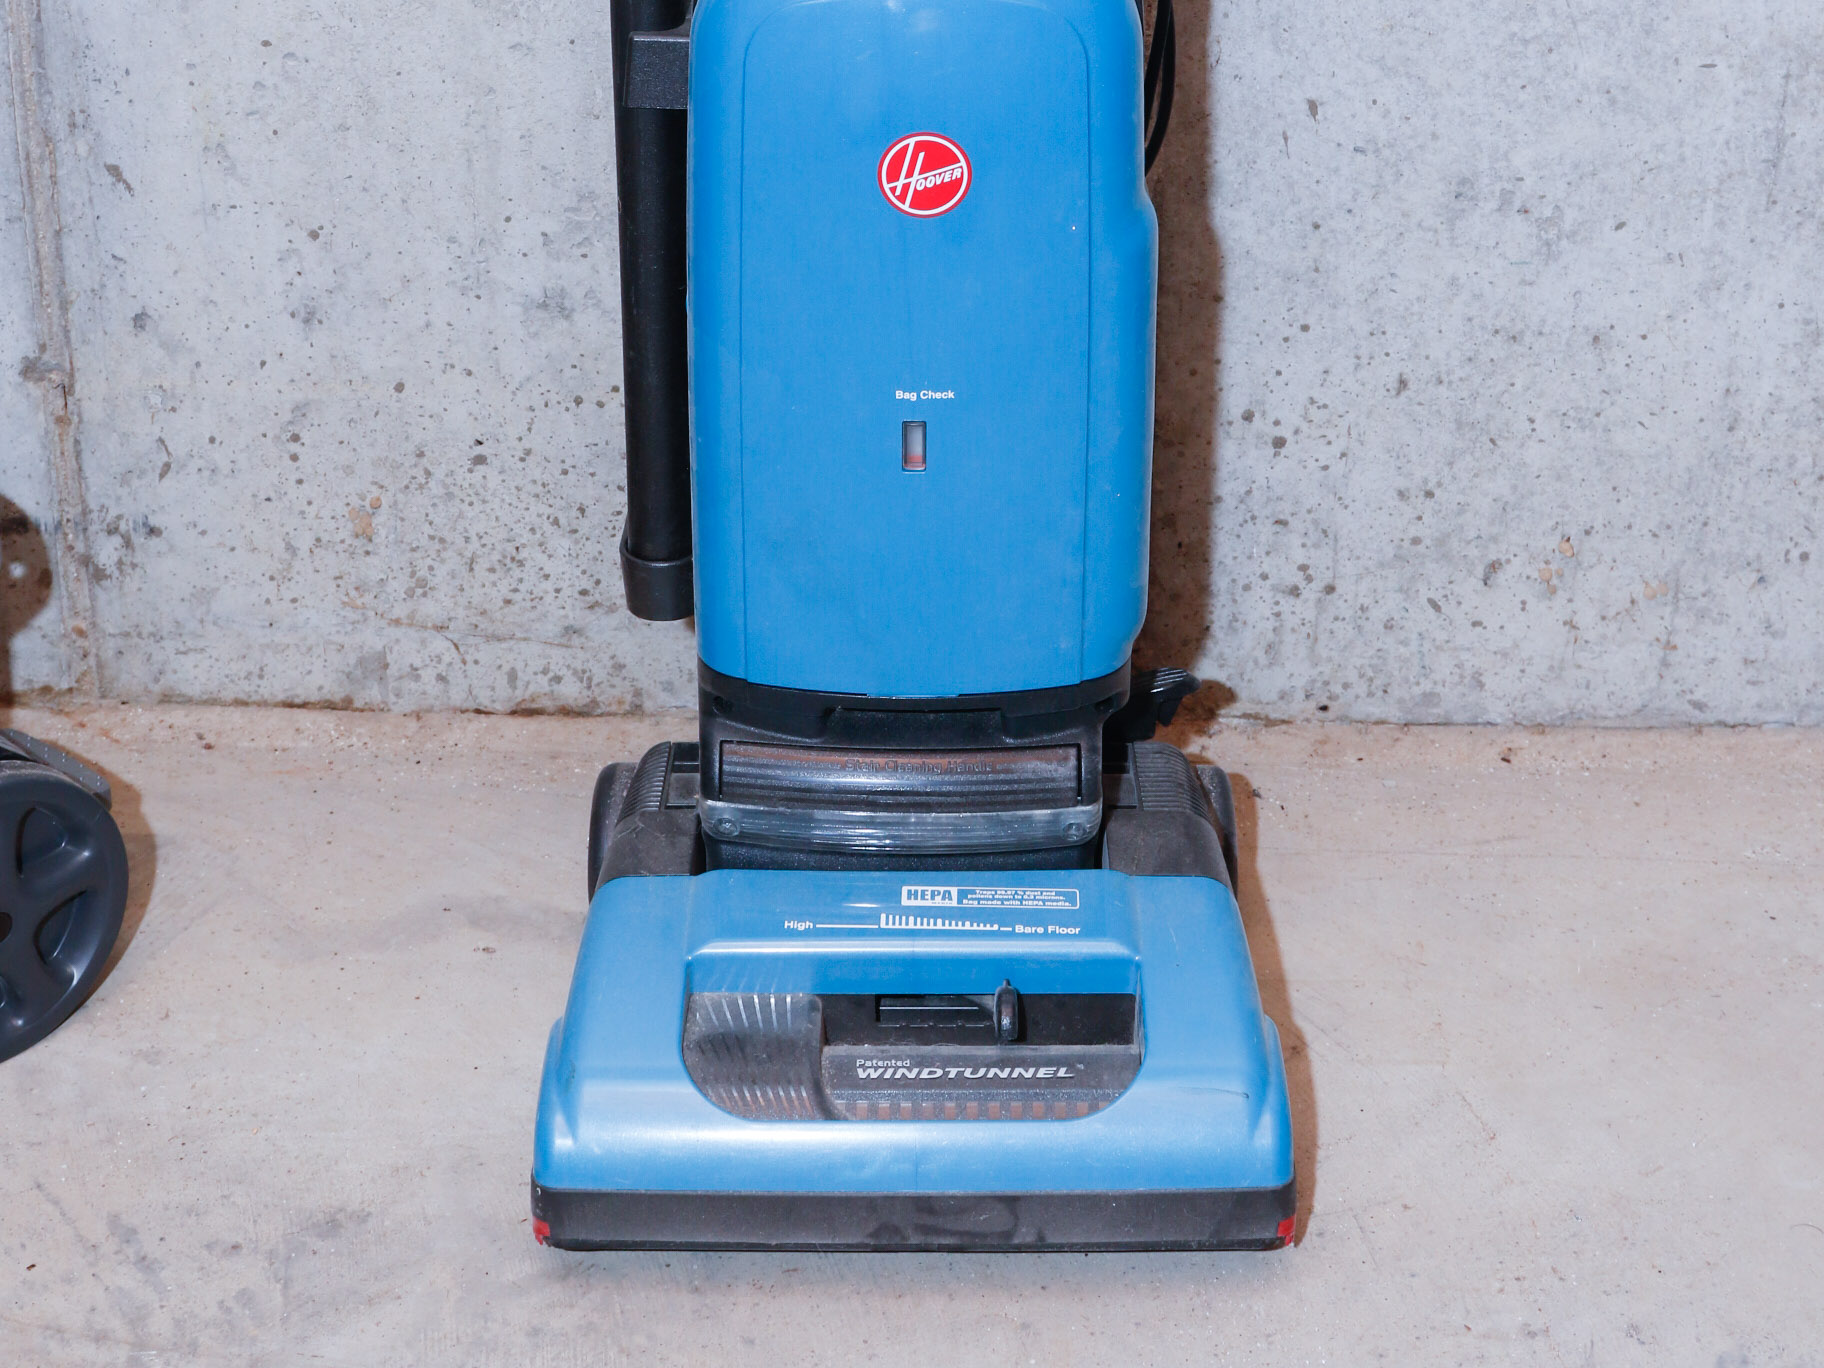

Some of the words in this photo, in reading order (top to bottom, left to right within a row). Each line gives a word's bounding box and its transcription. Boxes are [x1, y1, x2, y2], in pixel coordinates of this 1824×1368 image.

[895, 390, 917, 401] Bag
[920, 390, 955, 400] Check
[844, 758, 880, 772] Stair
[885, 759, 942, 774] Cleaning
[947, 760, 993, 773] Handle
[906, 888, 953, 902] HEPA
[784, 920, 814, 931] High
[1015, 924, 1045, 934] Bare
[1047, 925, 1081, 935] Floor
[856, 1059, 910, 1067] Patented
[856, 1067, 1075, 1080] WINDTUNNEL
